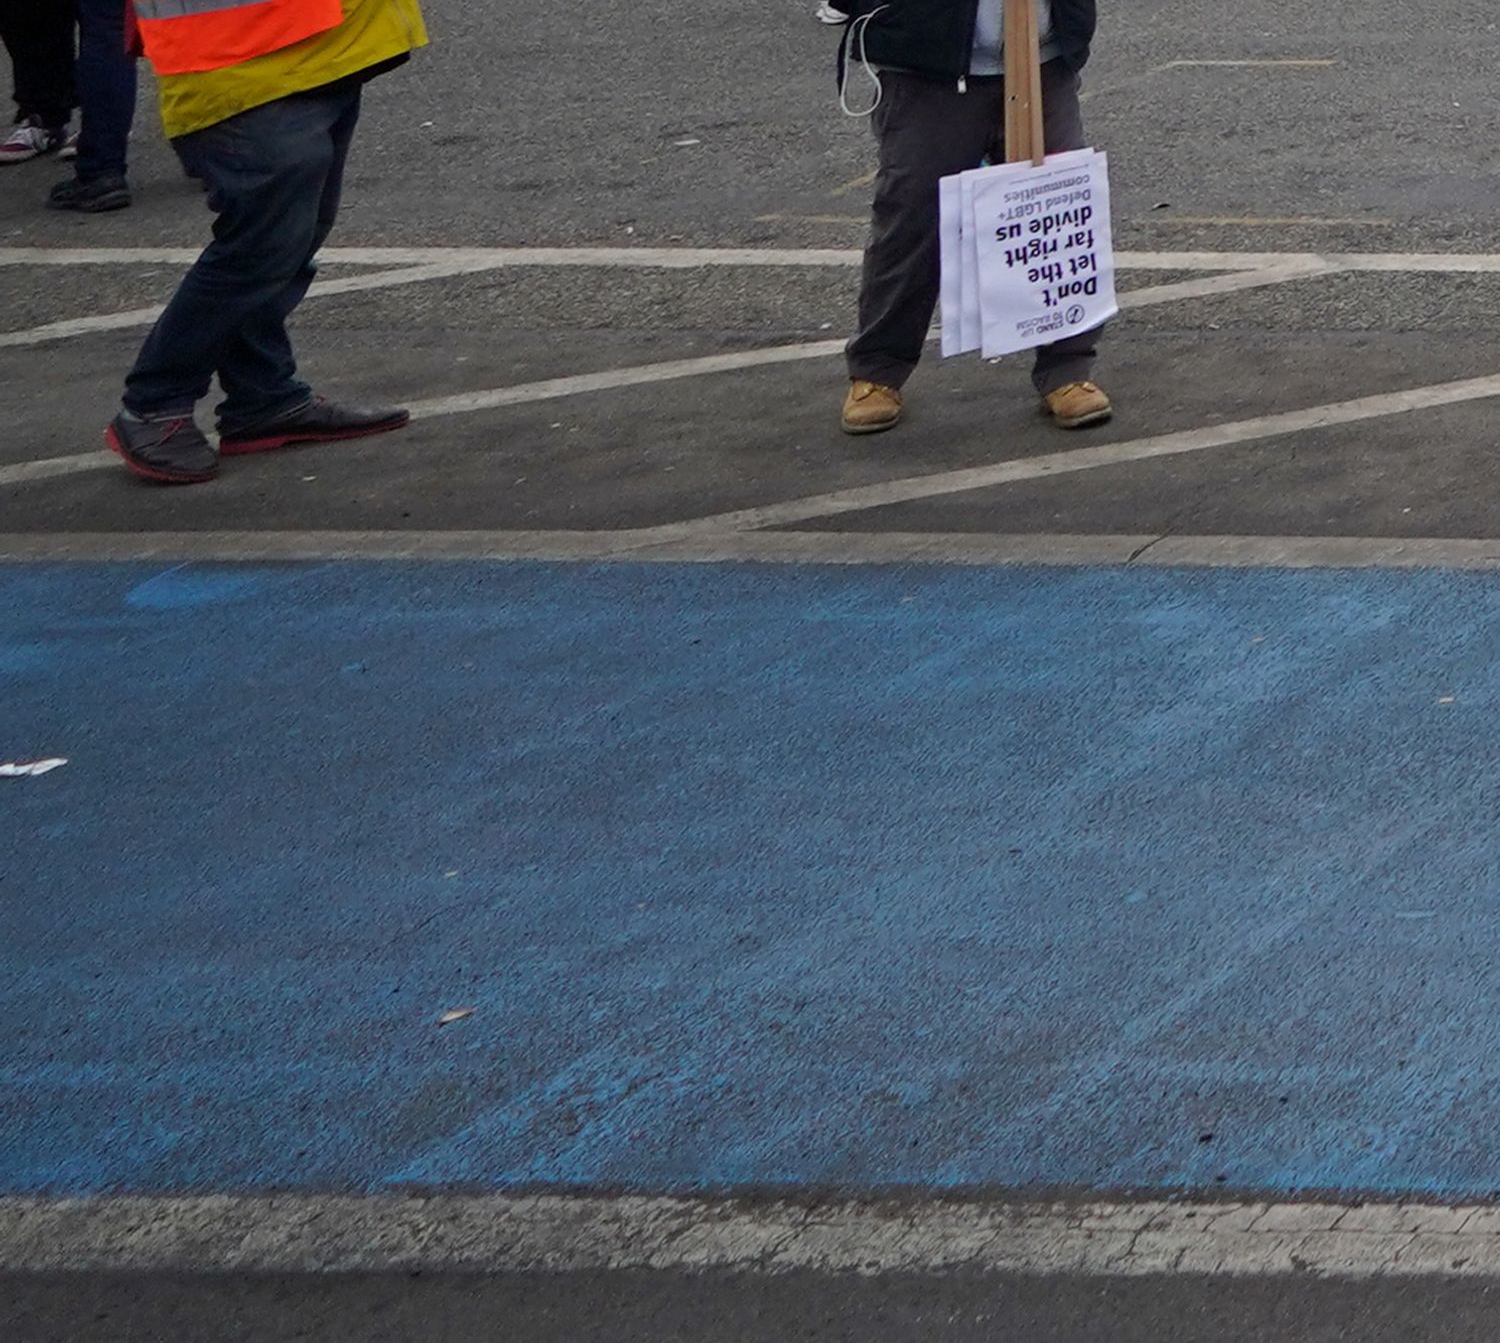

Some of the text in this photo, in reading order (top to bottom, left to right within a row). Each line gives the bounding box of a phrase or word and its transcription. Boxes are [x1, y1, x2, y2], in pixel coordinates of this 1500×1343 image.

[1004, 174, 1090, 203] communities
[998, 189, 1091, 220] Defend LGBT+
[996, 206, 1092, 242] divide us
[1005, 229, 1094, 268] far right
[1028, 254, 1096, 282] let the
[1043, 277, 1097, 307] Don't
